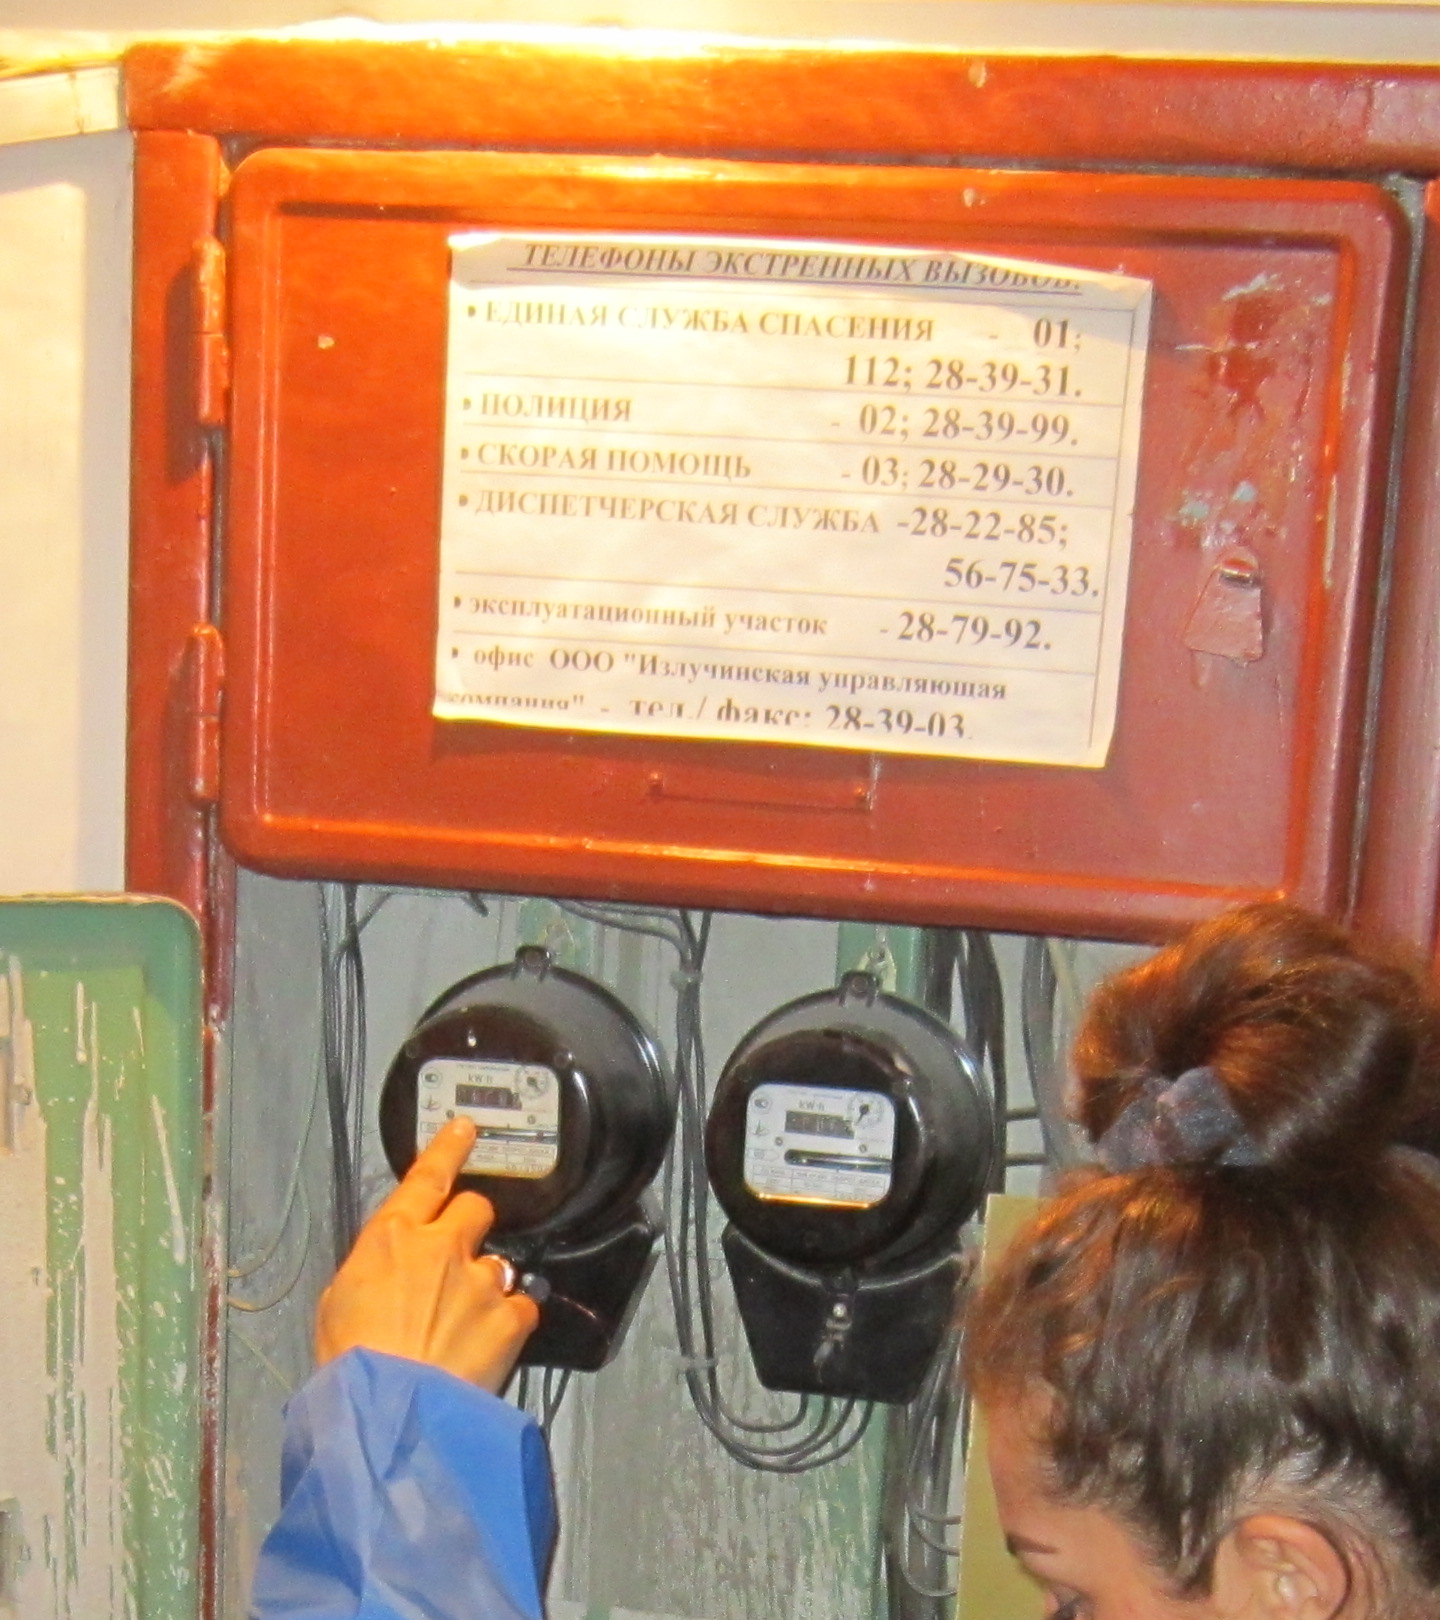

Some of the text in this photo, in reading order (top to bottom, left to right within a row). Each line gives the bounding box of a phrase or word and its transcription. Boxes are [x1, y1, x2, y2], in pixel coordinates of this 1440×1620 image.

[524, 243, 697, 272] ТЕЛЕФОНЫ
[707, 250, 916, 282] ЭКСТРЕННЫХ
[485, 301, 1082, 354] ЕДИНАЯ СЛУЖБА СПАСЕНИЯ 01;
[844, 354, 1082, 398] 112; 28-39-31.
[480, 393, 1078, 446] ПОЛИЦИЯ 02; 28-39-99.
[476, 442, 1074, 499] СКОРАЯ ПОМОЩЬ 03; 28-29-30.
[474, 490, 739, 526] ДИСПЕТЧЕРСКАЯ
[747, 503, 880, 534] СЛУЖБА
[944, 557, 1100, 598] 56-75-33.
[469, 596, 1052, 651] эксплуатационный участок 28-79-92.
[473, 645, 1008, 700] офис ООО "Излучинская управляющая
